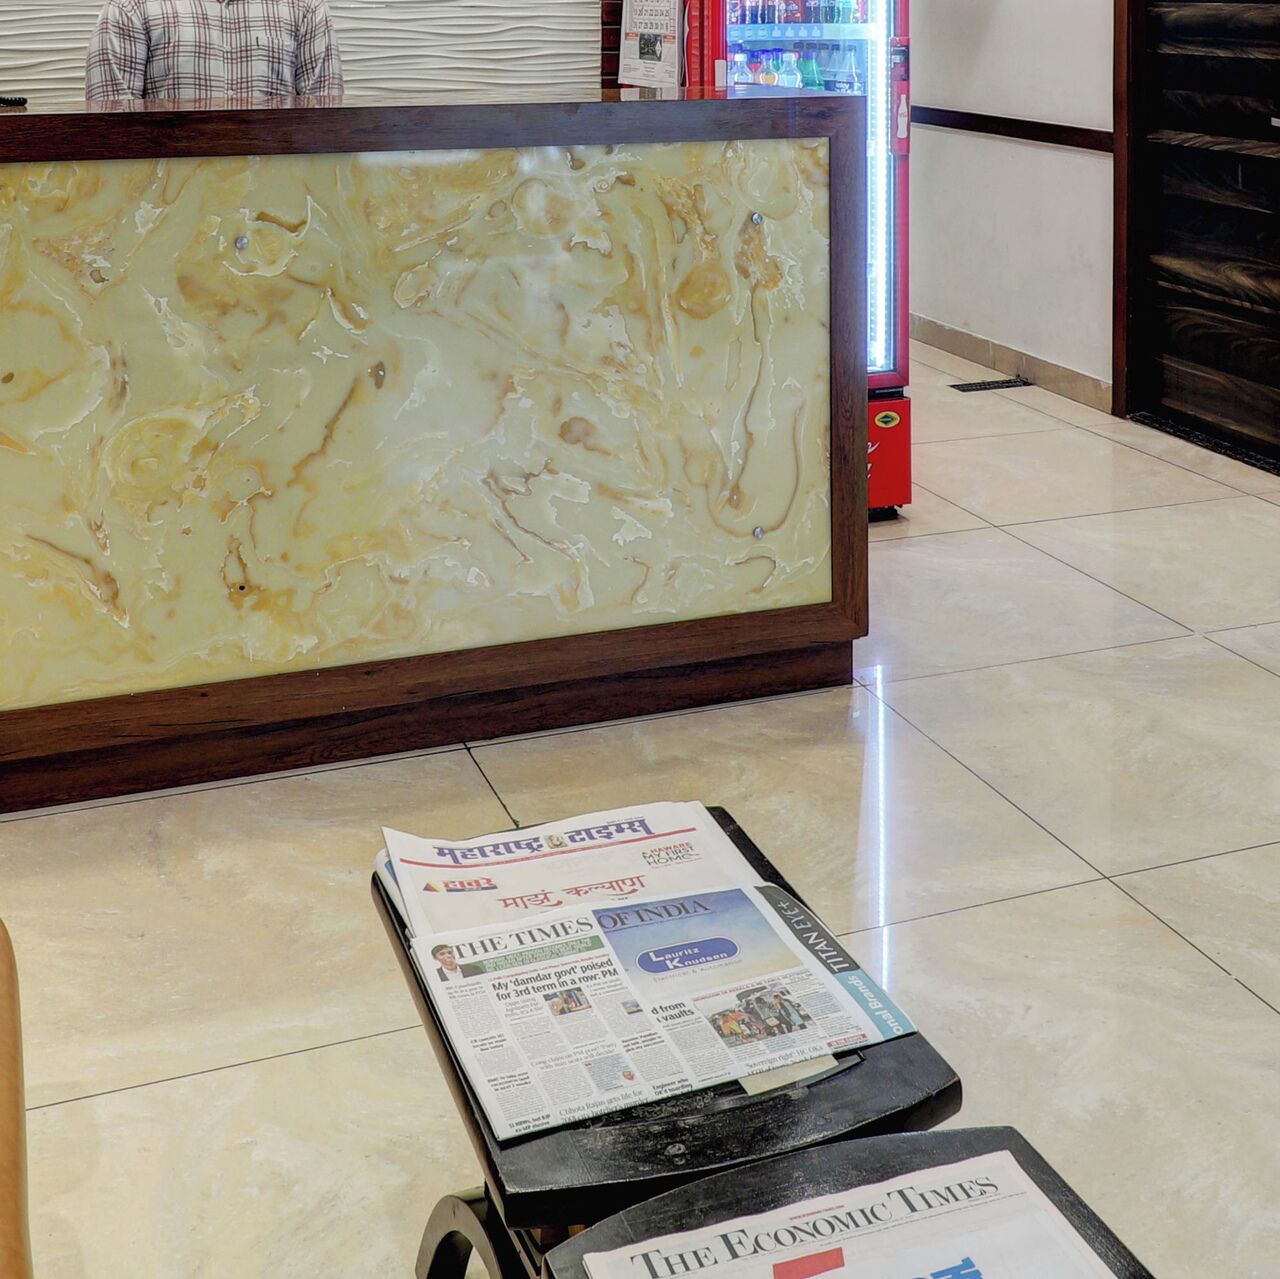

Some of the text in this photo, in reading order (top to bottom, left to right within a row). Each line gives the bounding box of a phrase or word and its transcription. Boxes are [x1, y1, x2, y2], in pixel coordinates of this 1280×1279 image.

[650, 842, 691, 854] HAWARE
[666, 846, 695, 856] FIRST
[452, 937, 508, 959] THE
[509, 917, 594, 947] TIMES
[597, 911, 628, 930] OF
[632, 900, 710, 924] INDIA
[778, 900, 850, 973] TITAN EYE+
[650, 947, 701, 963] Lauritz
[665, 952, 729, 970] Knudsen
[491, 980, 509, 991] My
[578, 957, 615, 974] poised
[495, 990, 512, 1001] for
[511, 986, 531, 997] 3rd
[531, 982, 557, 993] term
[556, 978, 568, 987] in
[577, 972, 601, 983] row:
[600, 967, 619, 978] PM
[848, 974, 883, 1010] Brands
[660, 1001, 686, 1014] from
[663, 1009, 696, 1024] vaults
[631, 1176, 999, 1279] THE ECONOMIC TIMES
